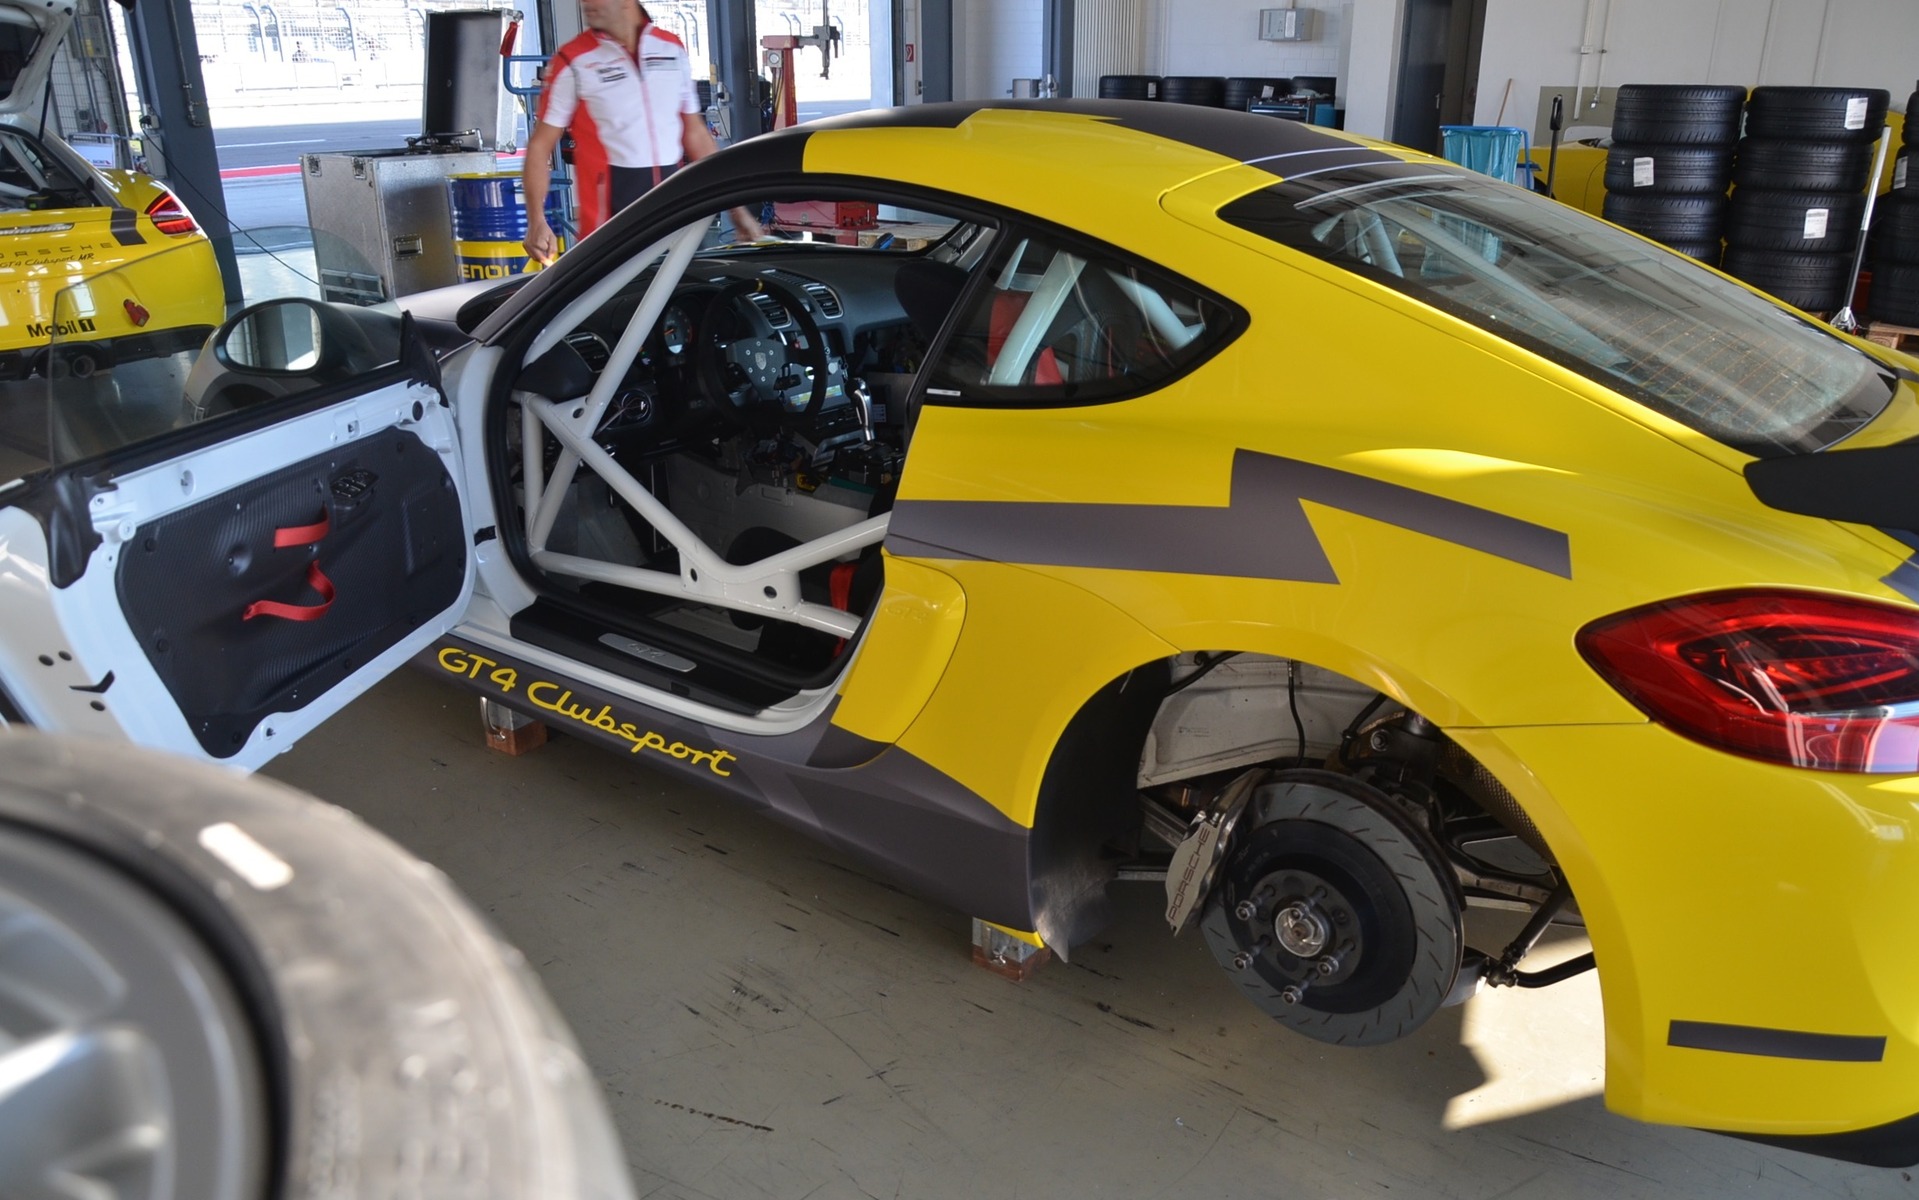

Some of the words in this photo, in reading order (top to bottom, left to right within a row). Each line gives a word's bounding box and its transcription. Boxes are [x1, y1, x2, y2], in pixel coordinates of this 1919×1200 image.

[25, 254, 74, 267] Clubsport
[78, 252, 95, 262] MR
[26, 320, 78, 338] Mobil
[438, 647, 517, 693] GT4
[527, 681, 737, 777] Clubsport
[1168, 827, 1211, 921] PORSCHE
